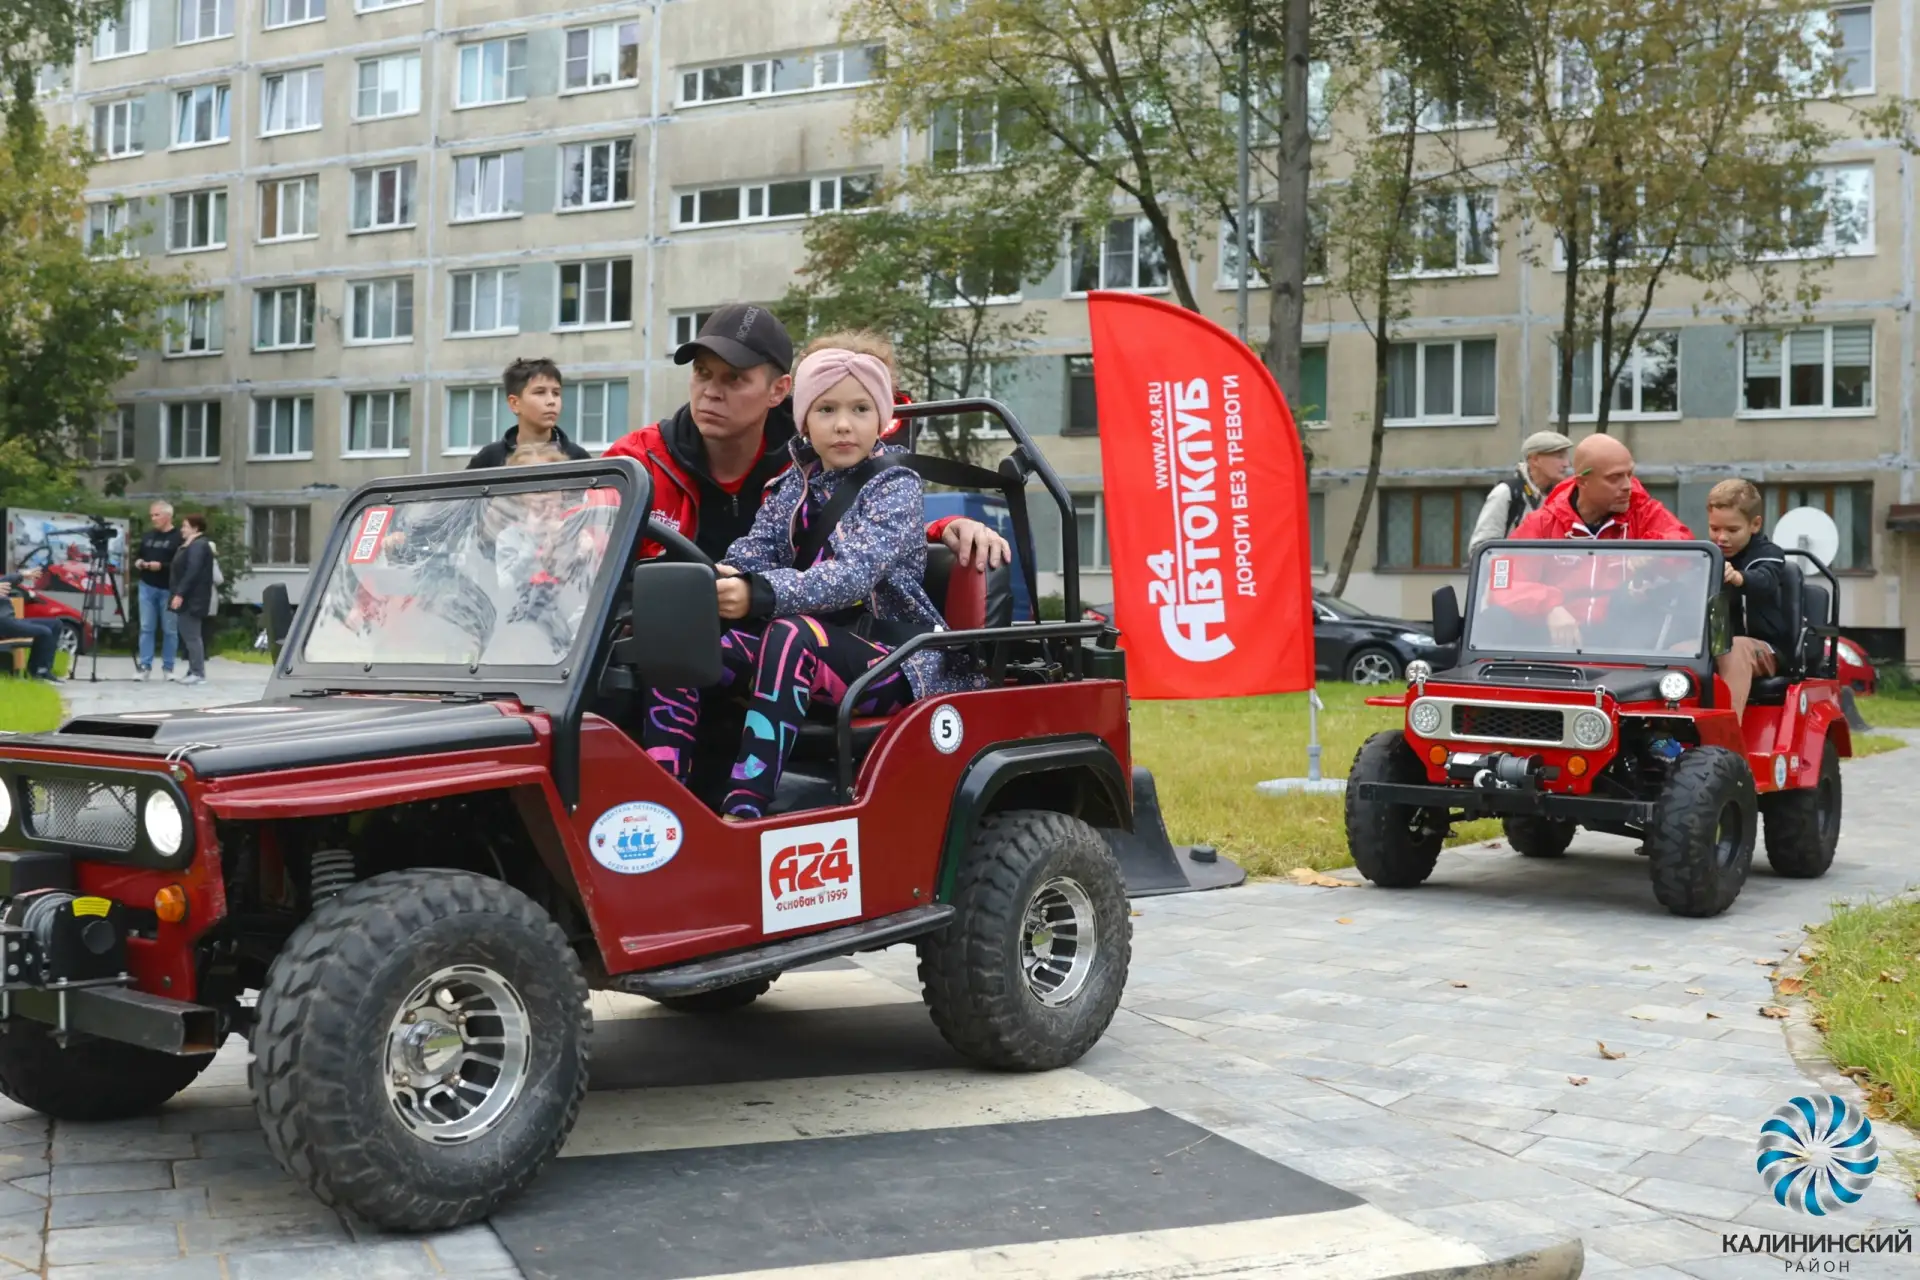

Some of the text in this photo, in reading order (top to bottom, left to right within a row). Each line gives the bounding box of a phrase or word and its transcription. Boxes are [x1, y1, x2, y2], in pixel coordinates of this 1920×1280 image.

[1147, 381, 1169, 490] WWW.A24.RU
[1159, 377, 1236, 663] АВТОКЛУБ
[1223, 375, 1256, 597] ДОРОГИ БЕЗ ТРЕВОГИ
[1146, 550, 1177, 604] 24
[942, 720, 952, 739] 5
[827, 888, 848, 903] 1999
